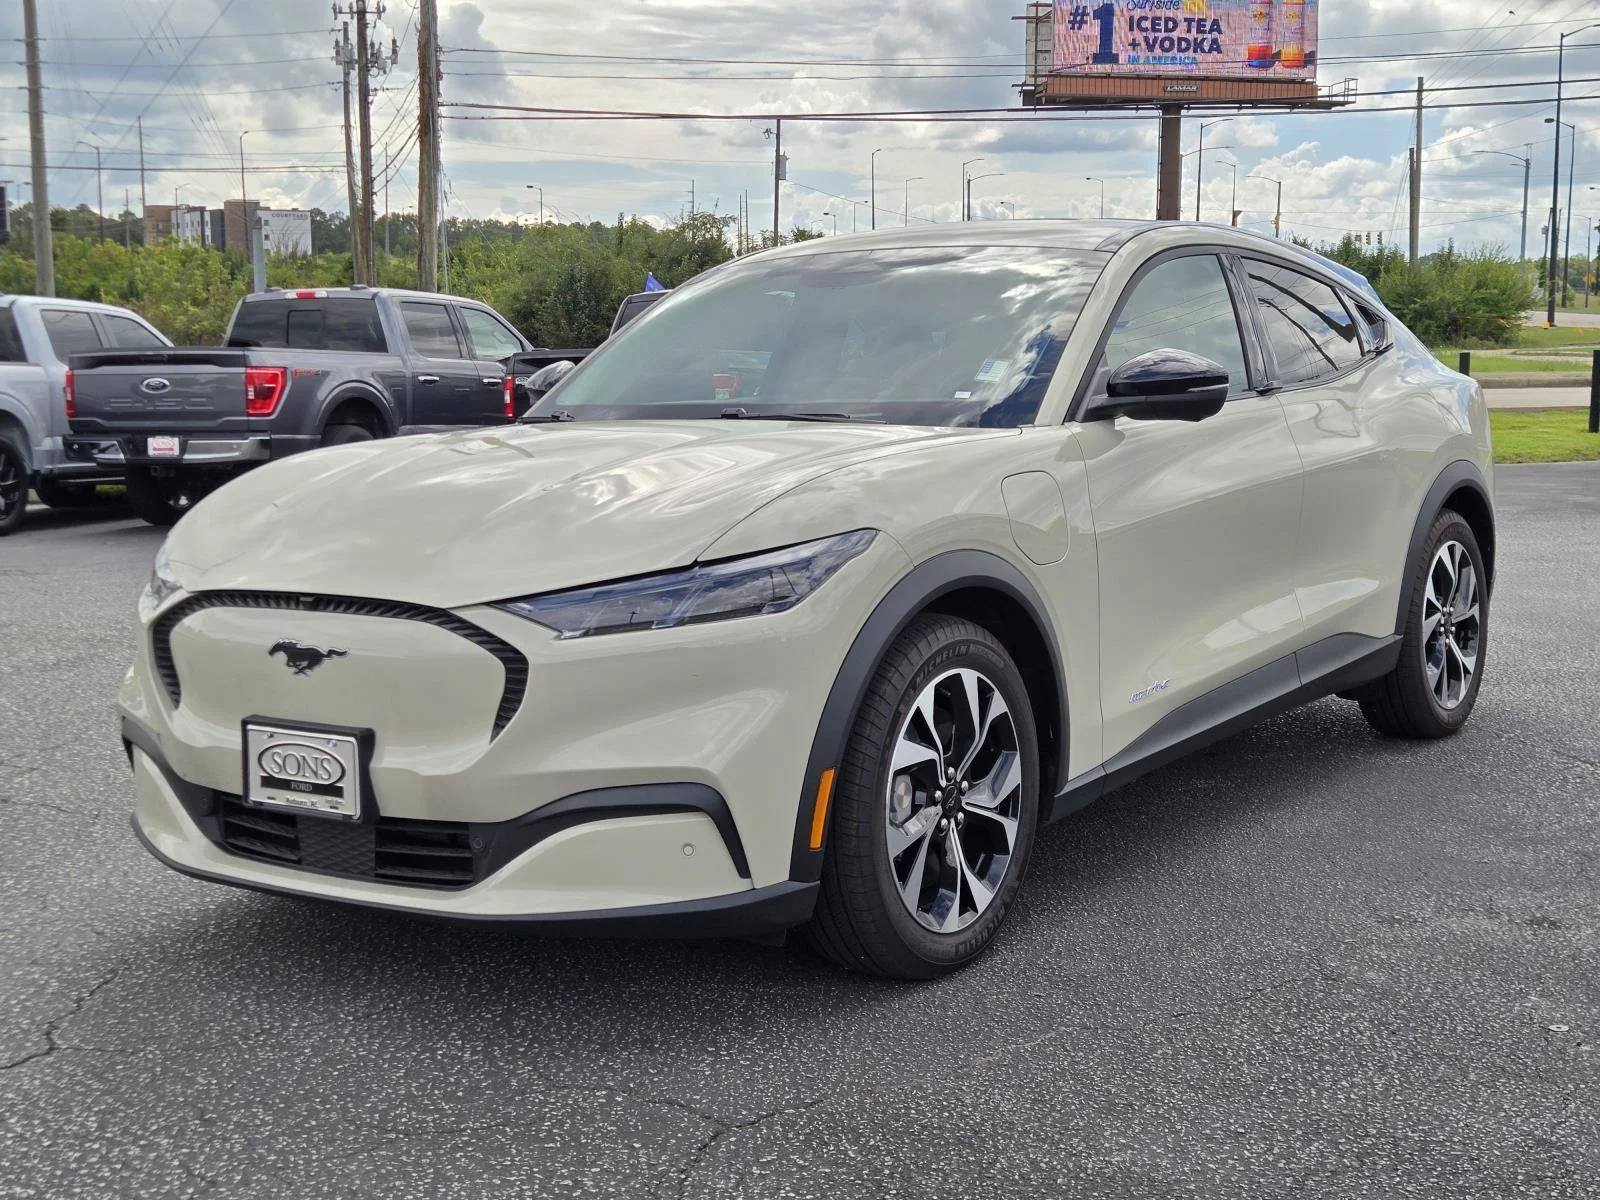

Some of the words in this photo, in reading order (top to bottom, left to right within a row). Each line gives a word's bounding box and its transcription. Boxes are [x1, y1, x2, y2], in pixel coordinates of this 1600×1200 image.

[1068, 3, 1119, 64] #1
[1128, 16, 1178, 33] ICED
[1184, 17, 1223, 34] TEA
[1127, 55, 1139, 63] IN
[1143, 55, 1198, 65] AMERICA
[913, 645, 969, 692] MICHELIN
[271, 750, 332, 781] SONS
[290, 782, 312, 792] FORD
